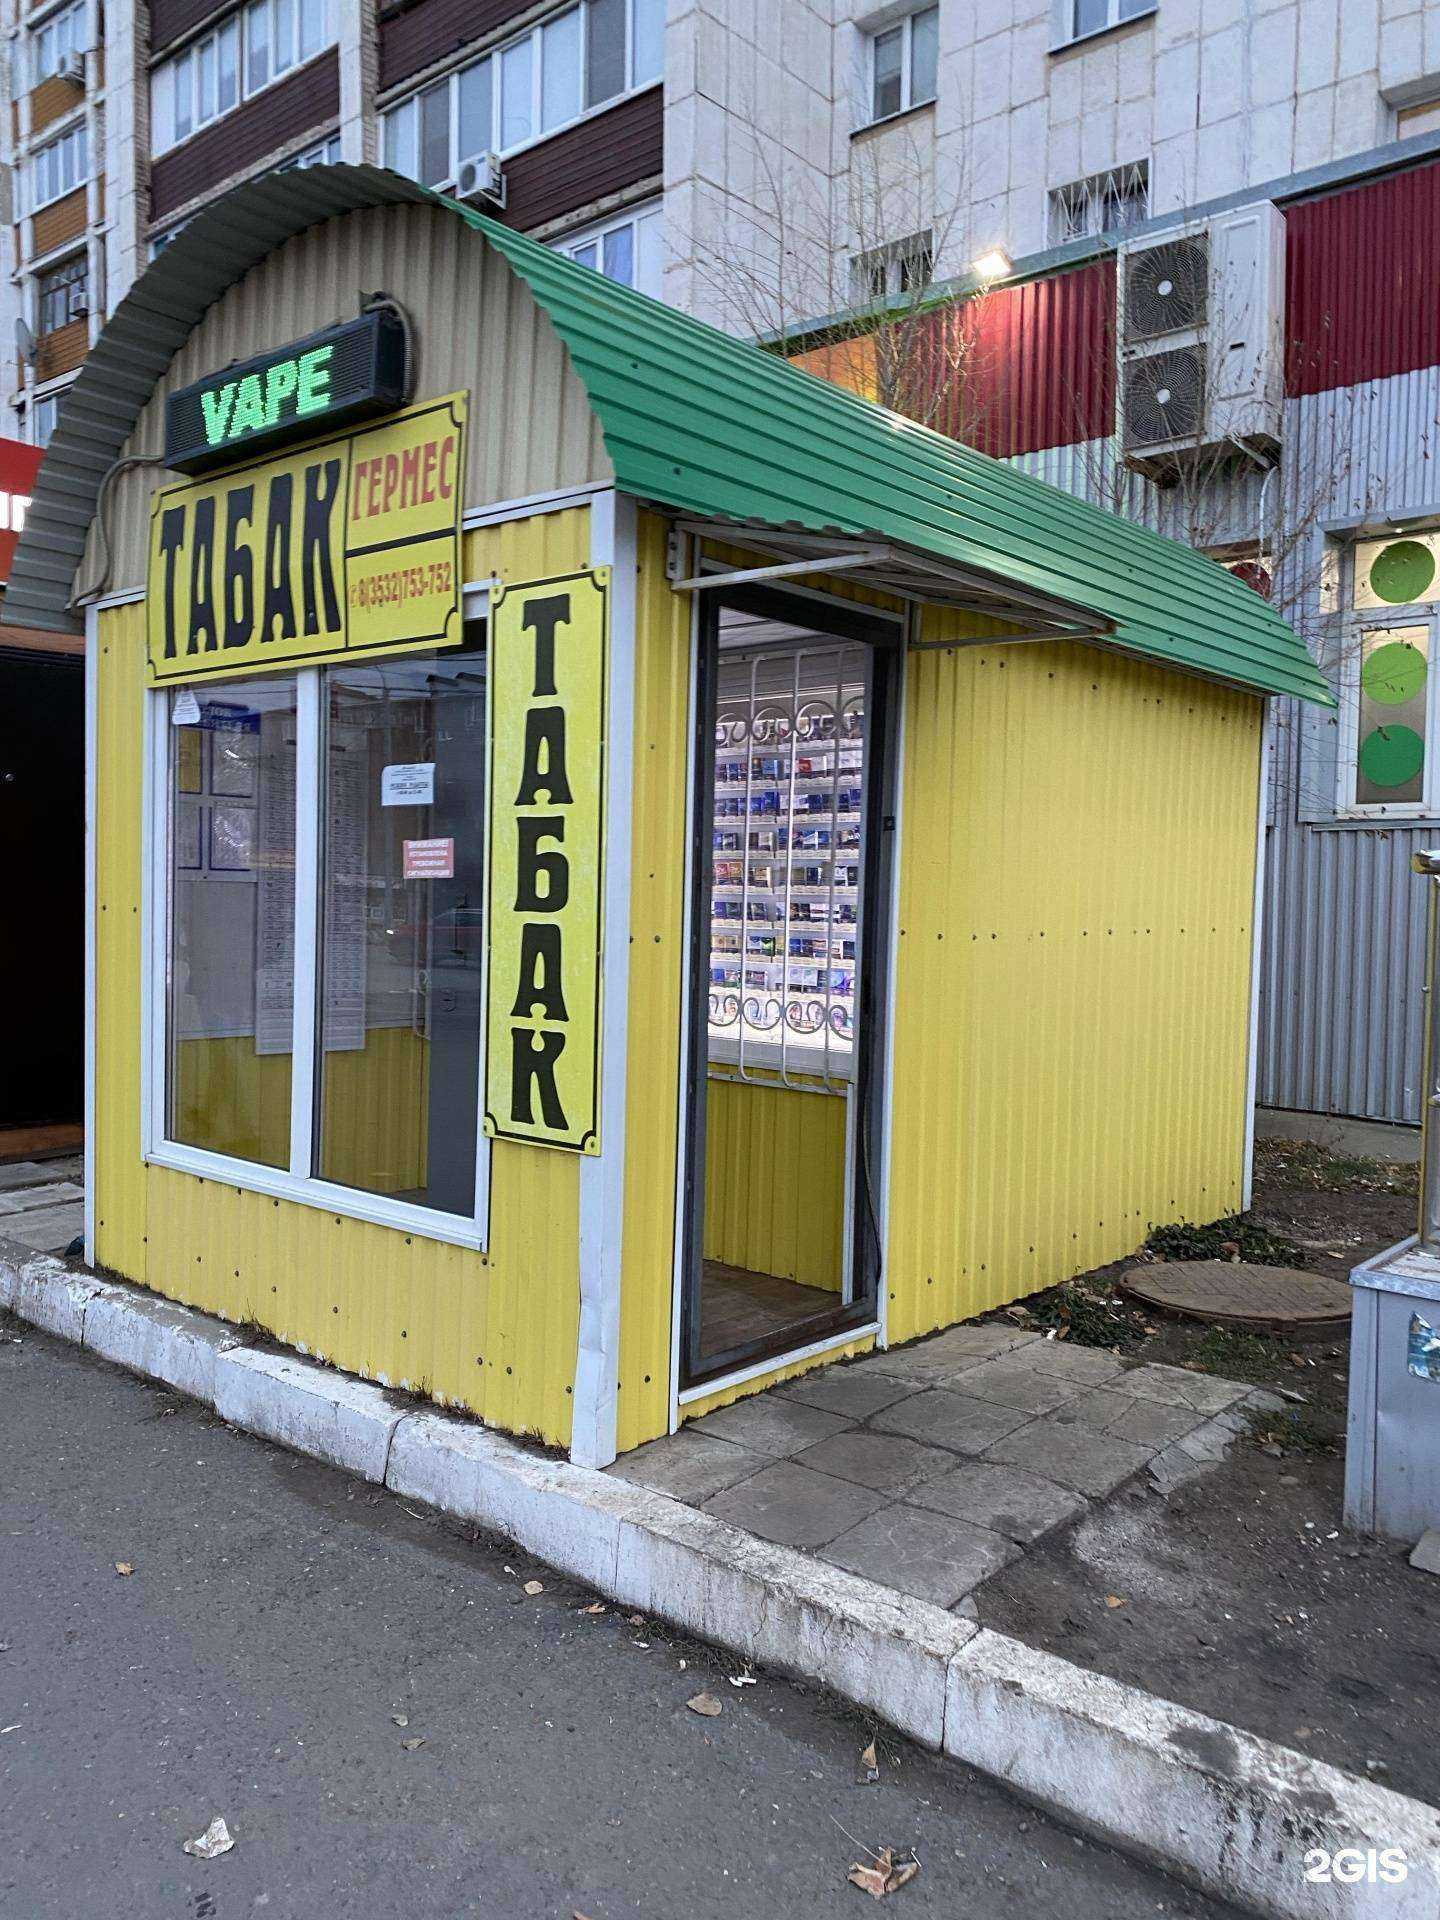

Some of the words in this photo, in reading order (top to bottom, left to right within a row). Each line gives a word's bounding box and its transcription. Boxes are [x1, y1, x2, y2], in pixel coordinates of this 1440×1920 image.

[201, 346, 333, 445] VAPE
[352, 436, 454, 520] ГЕРМЕС
[159, 458, 341, 659] ТАБАК
[510, 593, 573, 1131] ТАБАК
